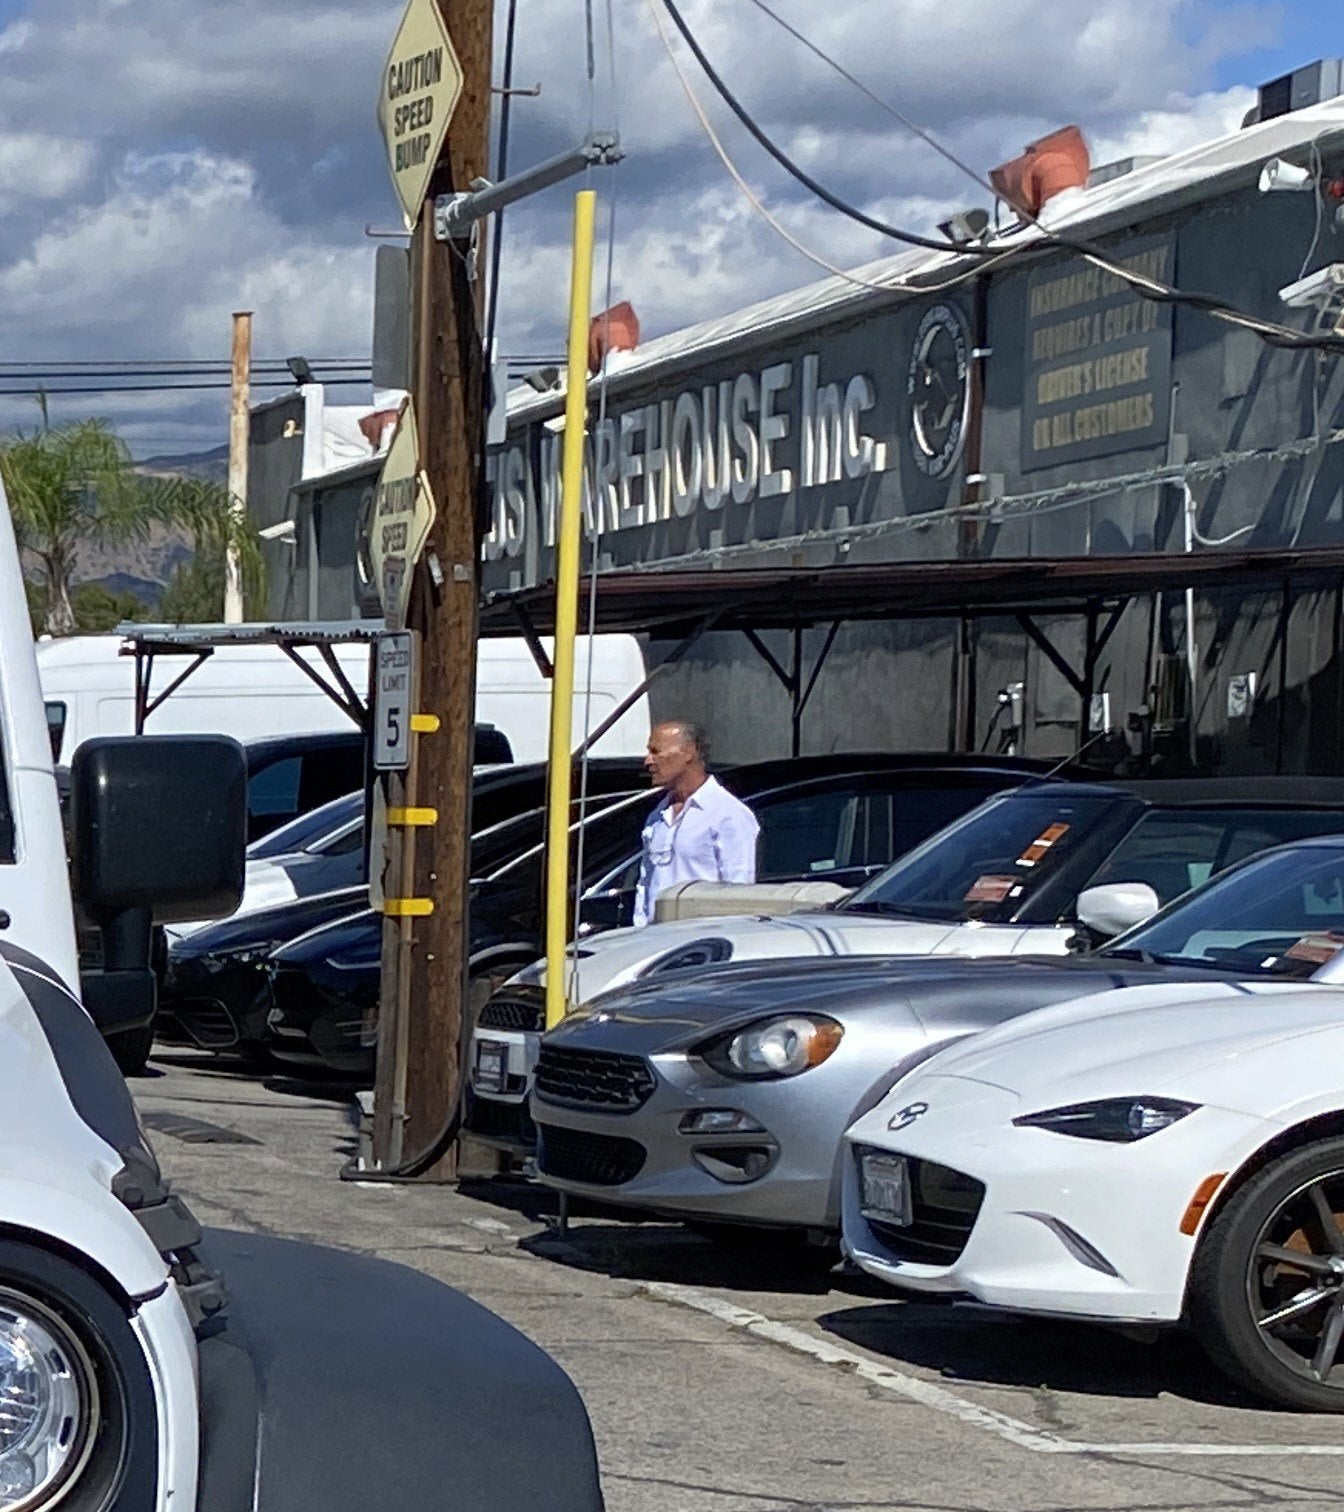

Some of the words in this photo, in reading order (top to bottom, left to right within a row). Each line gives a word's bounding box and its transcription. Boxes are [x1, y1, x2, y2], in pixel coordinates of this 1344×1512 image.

[388, 46, 443, 100] CAUTION
[394, 95, 433, 136] SPEED
[395, 133, 431, 172] BUMP
[801, 354, 887, 488] Inc.
[381, 650, 408, 669] SPEED
[381, 673, 407, 693] LIMIT
[386, 707, 400, 748] 5
